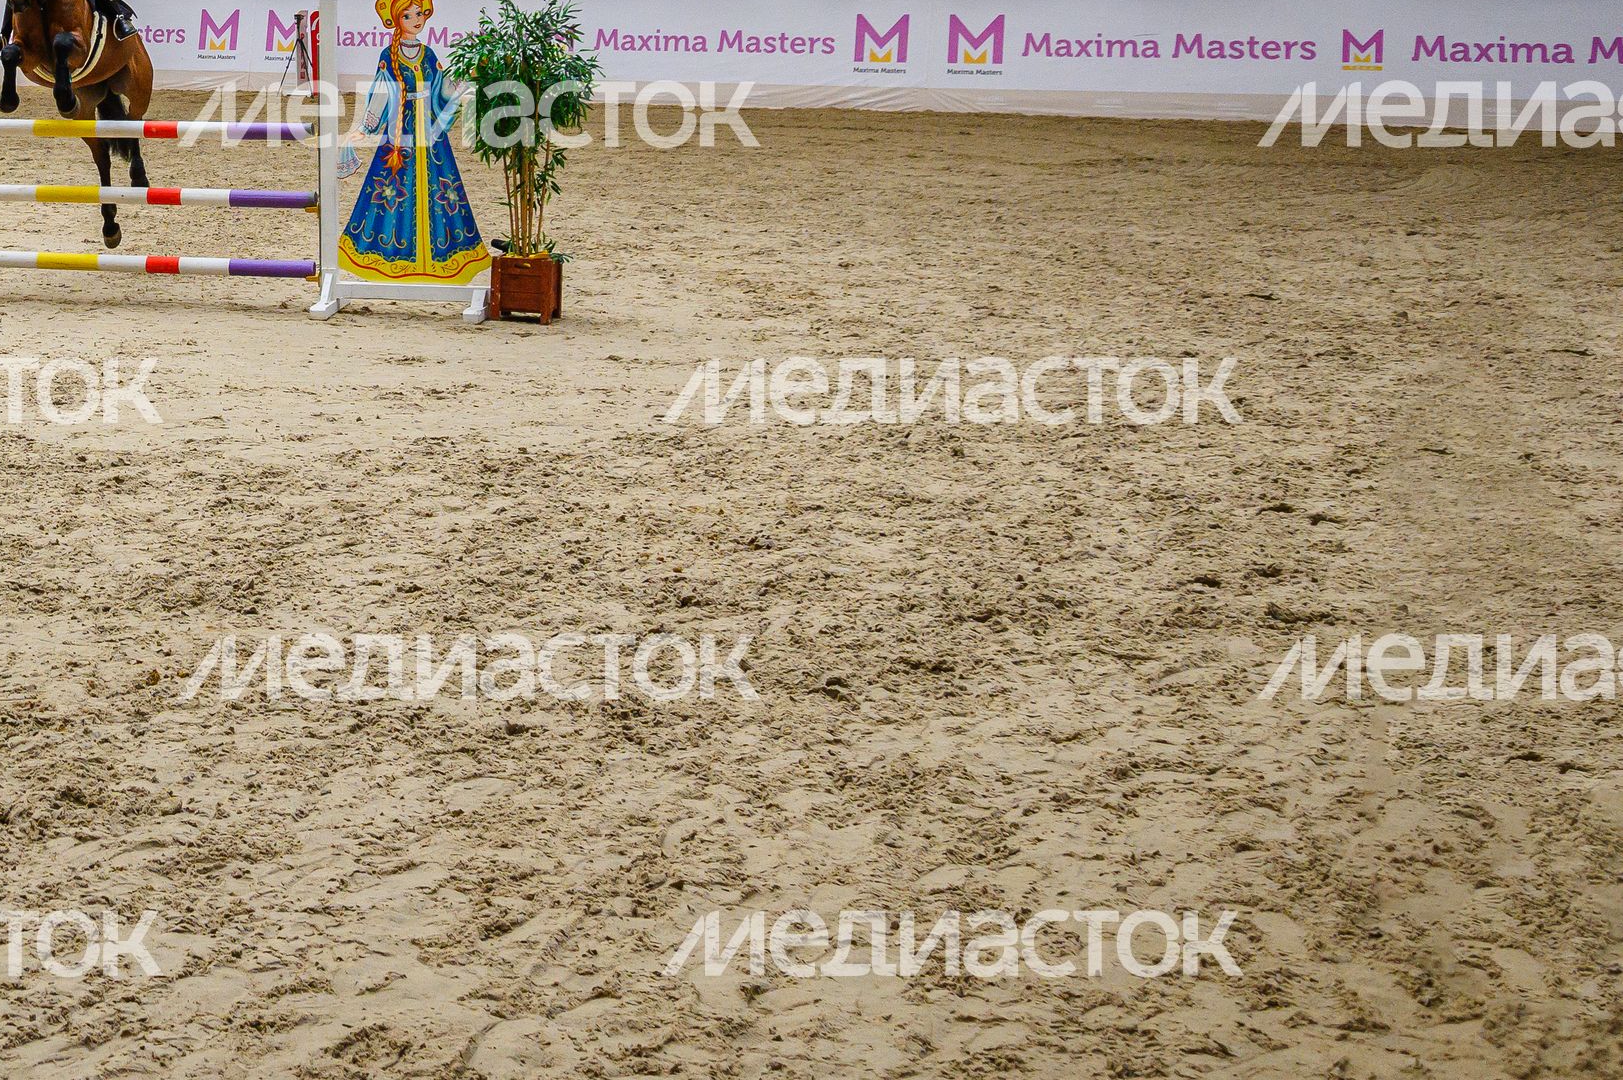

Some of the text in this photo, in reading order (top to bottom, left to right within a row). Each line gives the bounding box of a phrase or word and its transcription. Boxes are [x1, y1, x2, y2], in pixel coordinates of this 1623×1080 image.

[594, 28, 707, 53] Maxima
[717, 29, 836, 55] Masters
[1021, 32, 1161, 59] Maxima
[1172, 33, 1317, 61] Masters
[1411, 34, 1575, 65] Maxima
[853, 66, 879, 74] Maxima
[976, 68, 1003, 76] Masters
